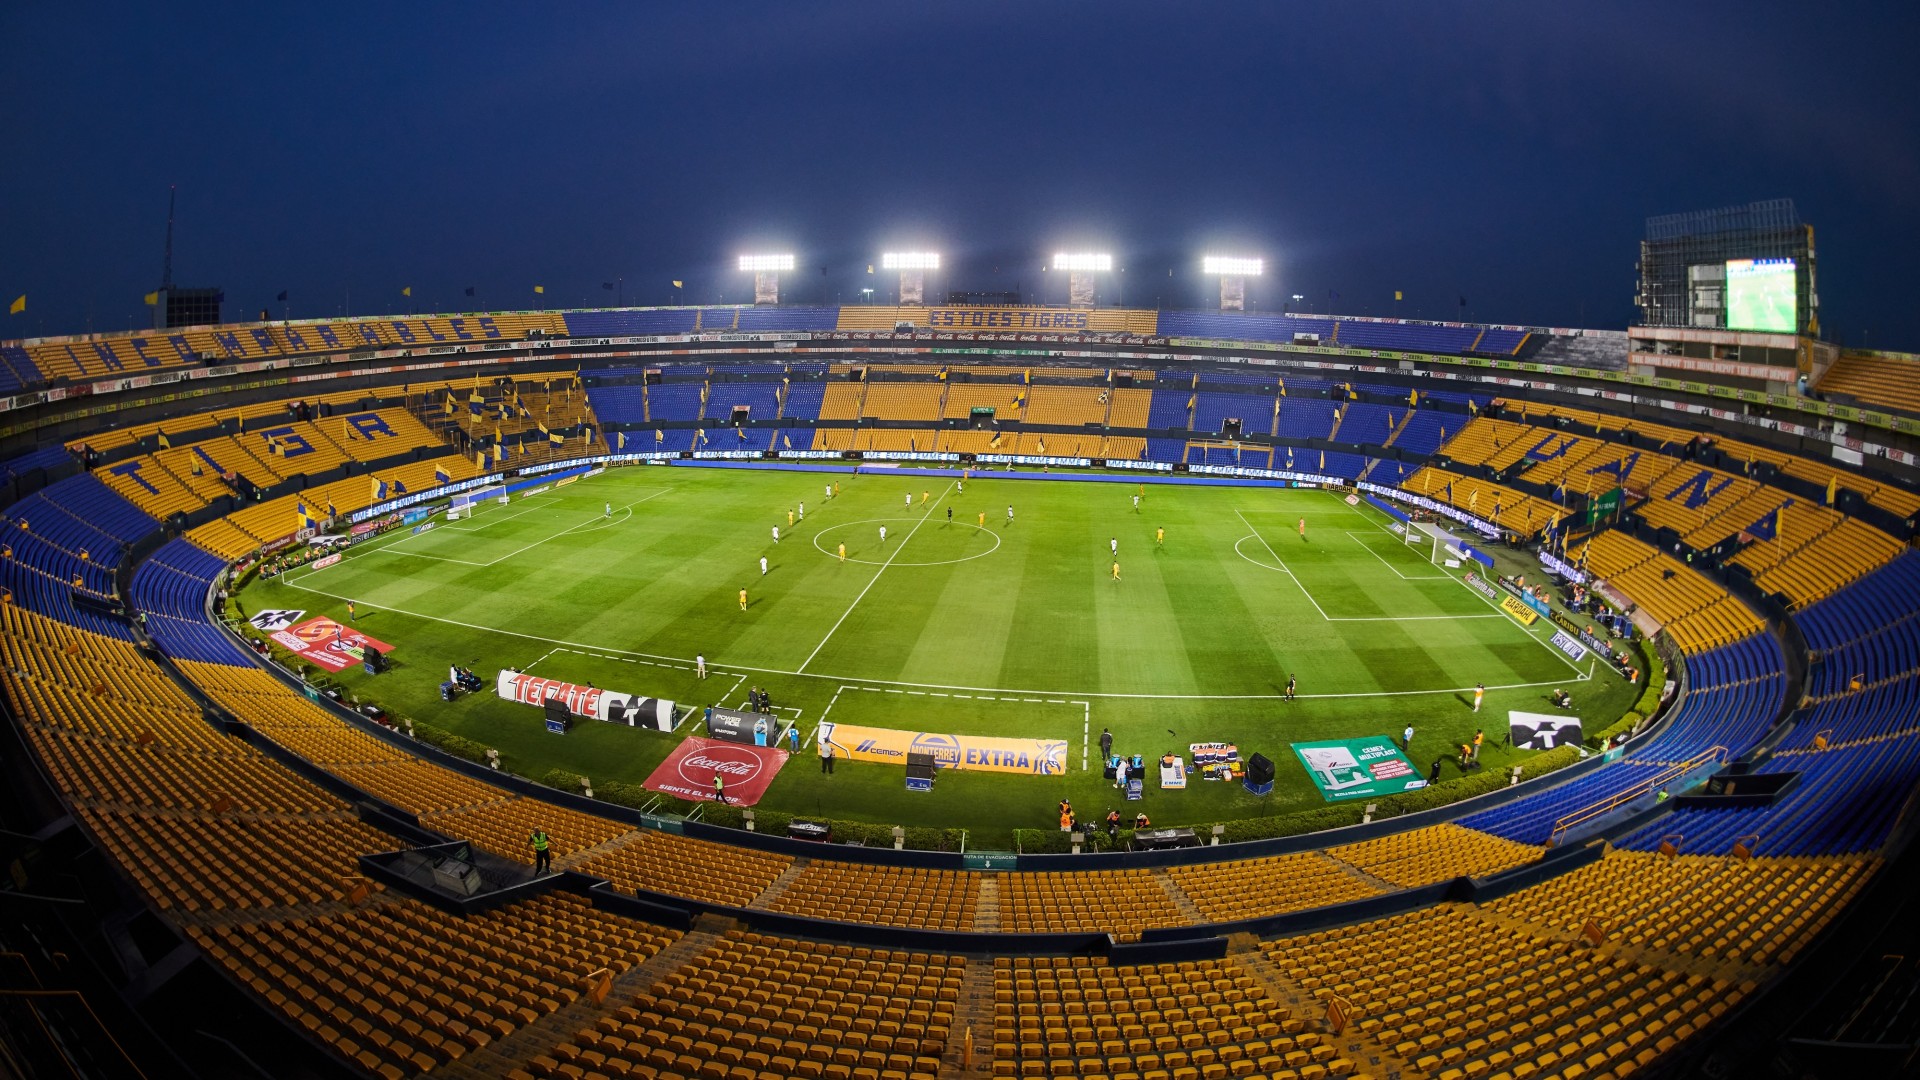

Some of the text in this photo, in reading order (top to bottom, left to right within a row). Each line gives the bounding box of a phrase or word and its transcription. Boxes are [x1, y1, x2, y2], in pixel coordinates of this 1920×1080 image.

[1018, 312, 1087, 328] TIGRES
[64, 317, 501, 376] INCOMPARABLES
[1632, 354, 1682, 367] THE HOME DEPOT
[1684, 360, 1735, 374] THE HOME DEPOT
[1737, 365, 1790, 381] THE HOME DEPOT
[1658, 379, 1672, 387] EXTRA
[1714, 387, 1728, 396] EXTRA
[1744, 391, 1758, 401] EXTRA
[1773, 396, 1787, 406] EXTRA
[1803, 401, 1818, 411] EXTRA
[1468, 573, 1497, 599] caliente.mx
[1505, 596, 1532, 621] BARDAHL
[1555, 614, 1579, 636] CARIBU
[509, 674, 604, 717] TECATE
[715, 714, 741, 723] POWER
[870, 748, 903, 757] CEMEX
[911, 745, 960, 761] MONTERREY
[1358, 749, 1397, 760] MULTIPLAST
[1362, 745, 1385, 753] CEMEX
[684, 755, 758, 775] Coca-Cola
[966, 749, 1029, 768] EXTRA
[659, 784, 690, 795] SIENTE
[705, 792, 738, 803] SAOR
